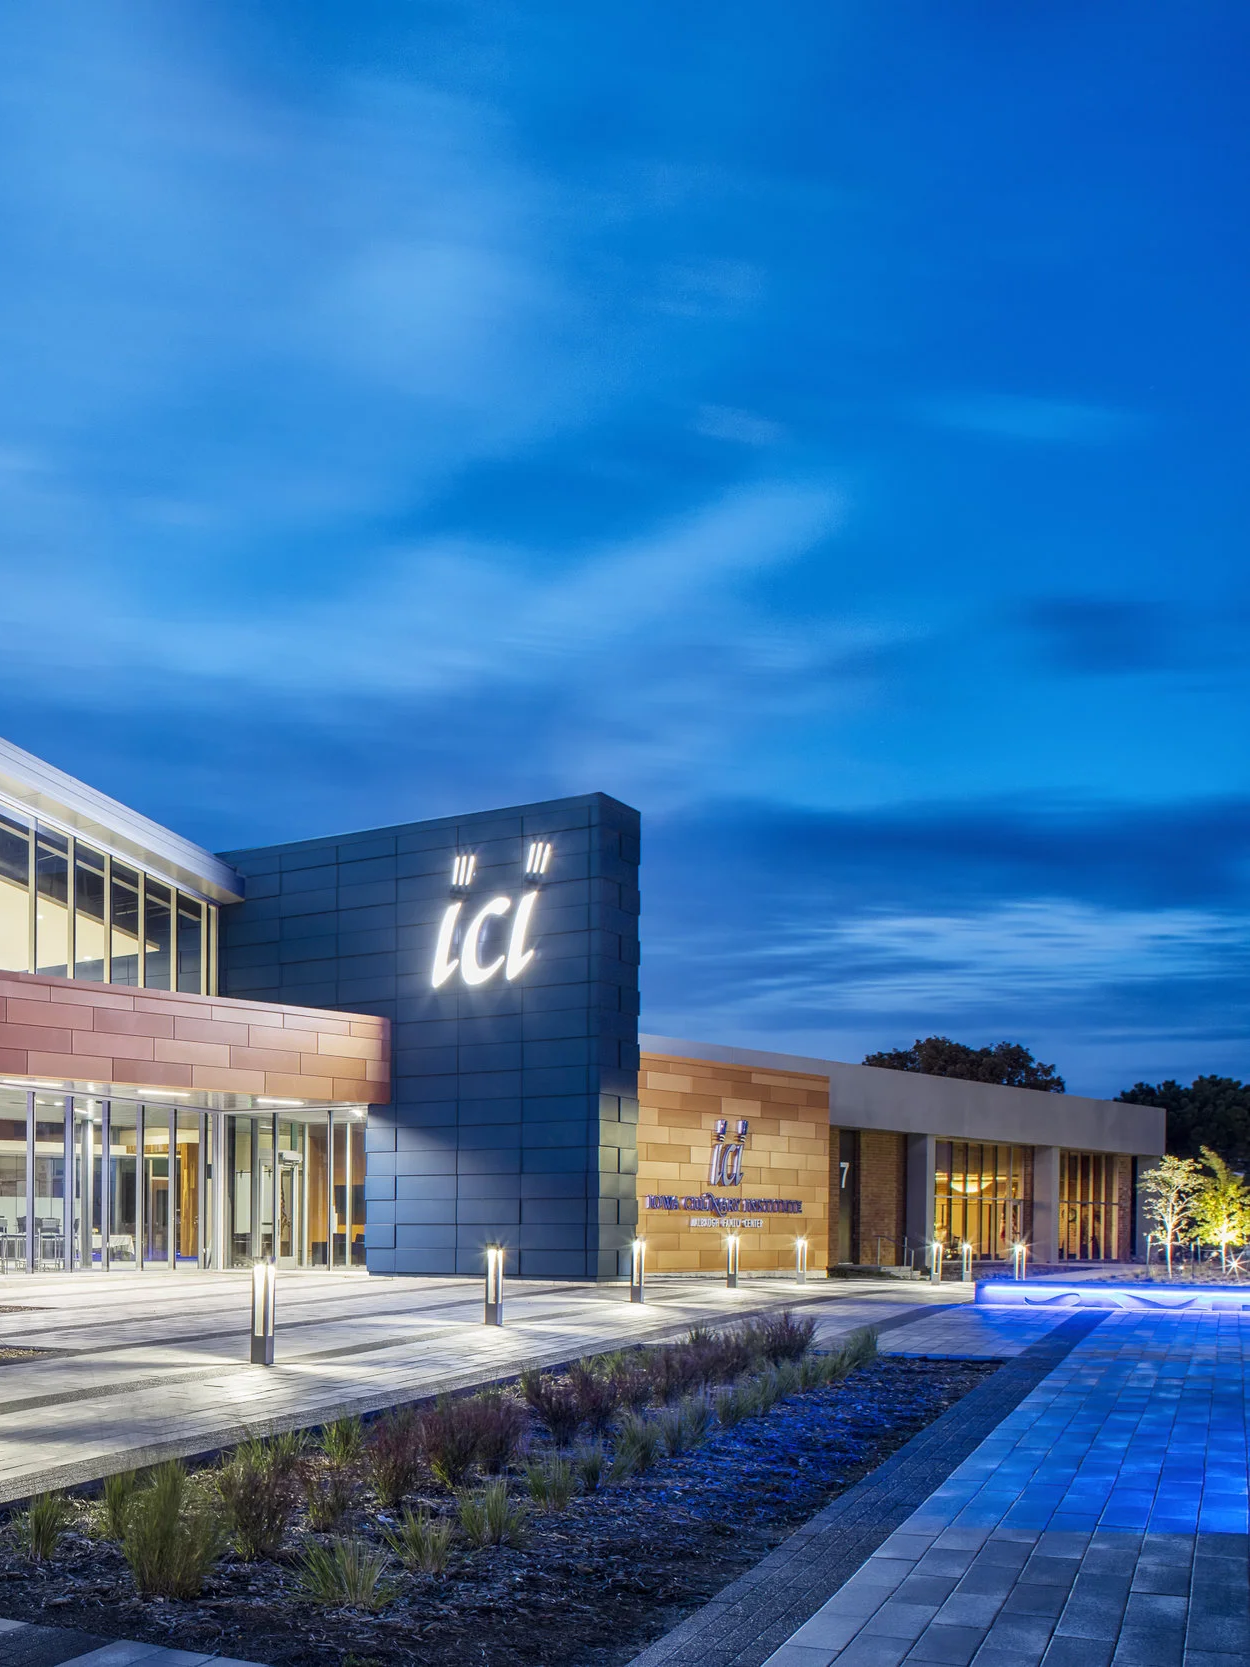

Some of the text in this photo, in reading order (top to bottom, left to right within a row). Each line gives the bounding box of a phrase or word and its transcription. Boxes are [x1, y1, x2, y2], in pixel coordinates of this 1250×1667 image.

[431, 841, 551, 988] ici
[840, 1162, 850, 1188] 7
[646, 1193, 803, 1217] IOWA CULINARY INSTITUTE
